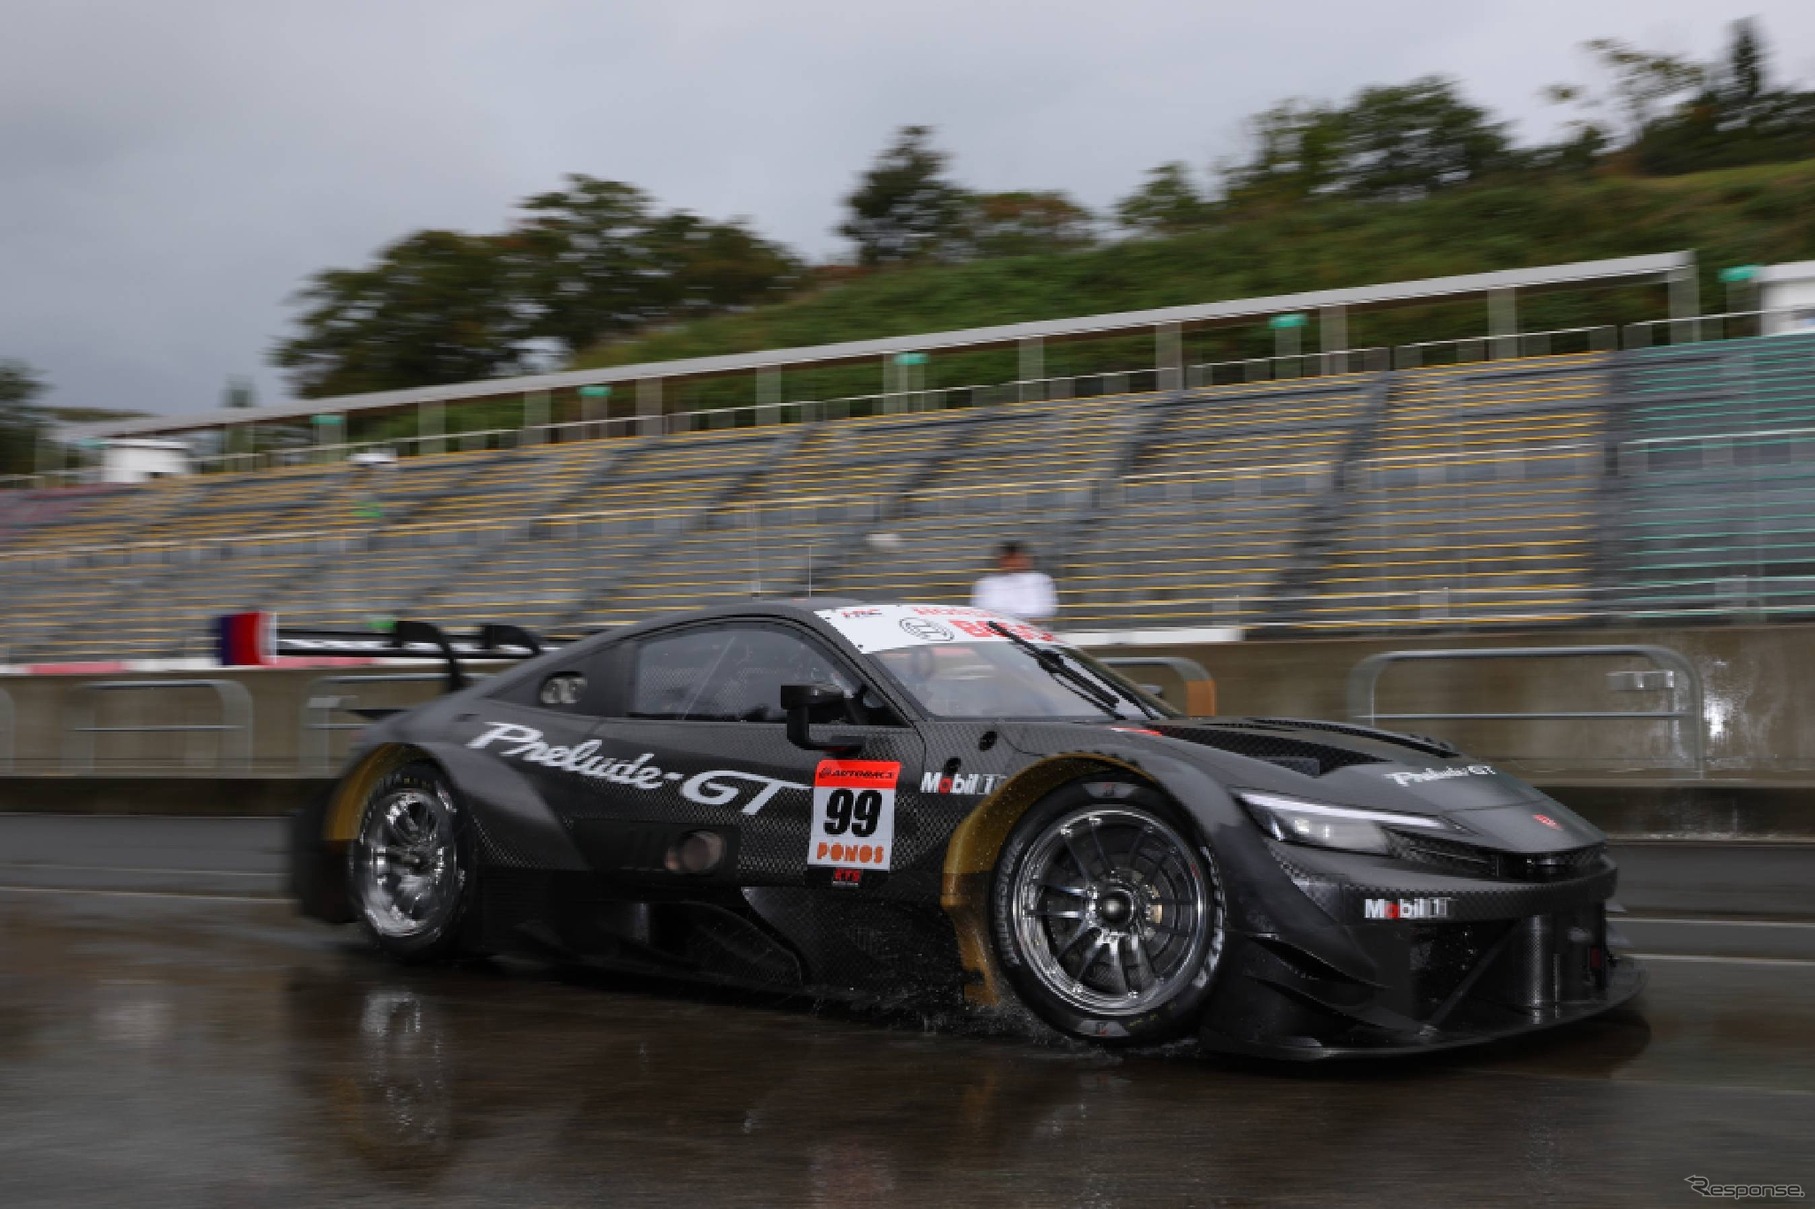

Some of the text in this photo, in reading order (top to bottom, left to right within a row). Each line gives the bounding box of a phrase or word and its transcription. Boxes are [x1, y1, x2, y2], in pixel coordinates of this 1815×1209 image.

[465, 721, 814, 816] Prelude-GT
[920, 772, 979, 795] Mobil
[823, 788, 883, 837] 99
[816, 842, 884, 864] PONOS
[1364, 897, 1424, 919] Mobil
